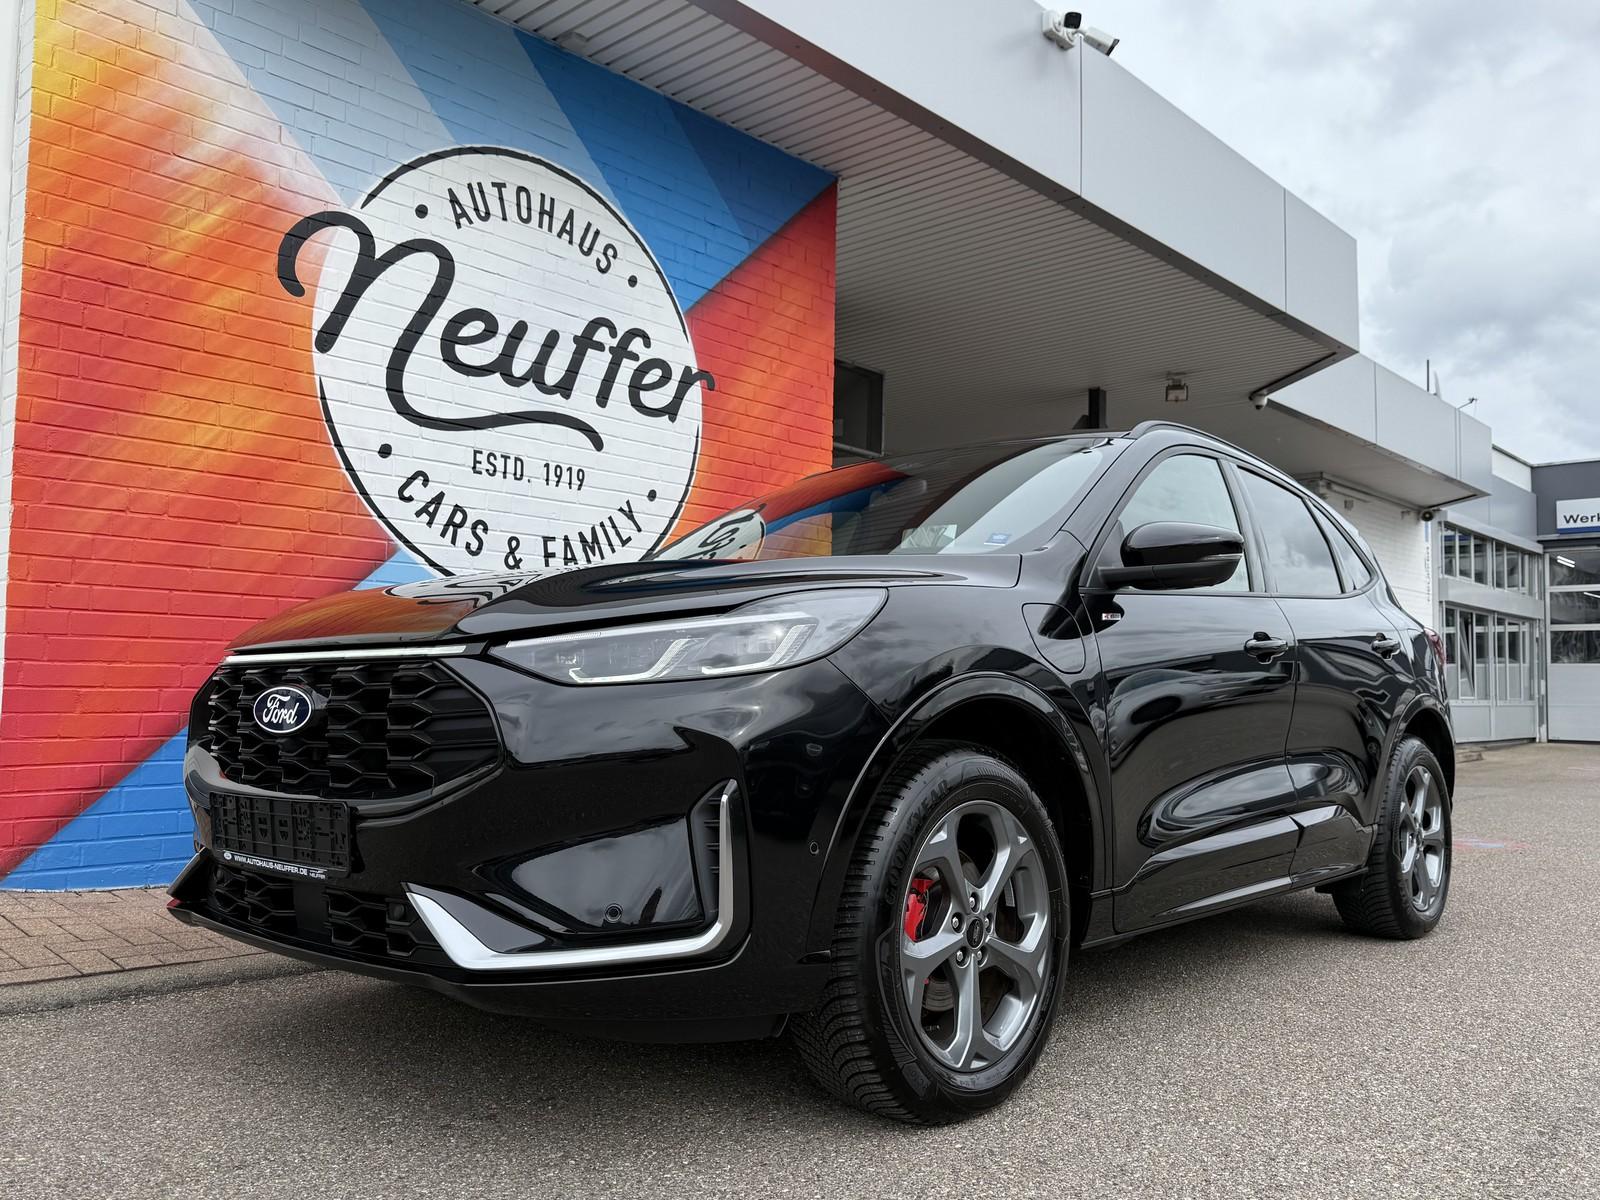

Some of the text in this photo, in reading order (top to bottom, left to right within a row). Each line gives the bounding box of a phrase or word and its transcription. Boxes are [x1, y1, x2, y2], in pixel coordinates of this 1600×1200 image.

[448, 181, 618, 274] AUTOHAUS
[277, 210, 716, 452] Neuffer
[471, 449, 586, 491] ESTD. 1919
[398, 470, 489, 557] CARS
[503, 536, 523, 570] &
[541, 499, 643, 568] FAMILY
[262, 693, 300, 724] Ford
